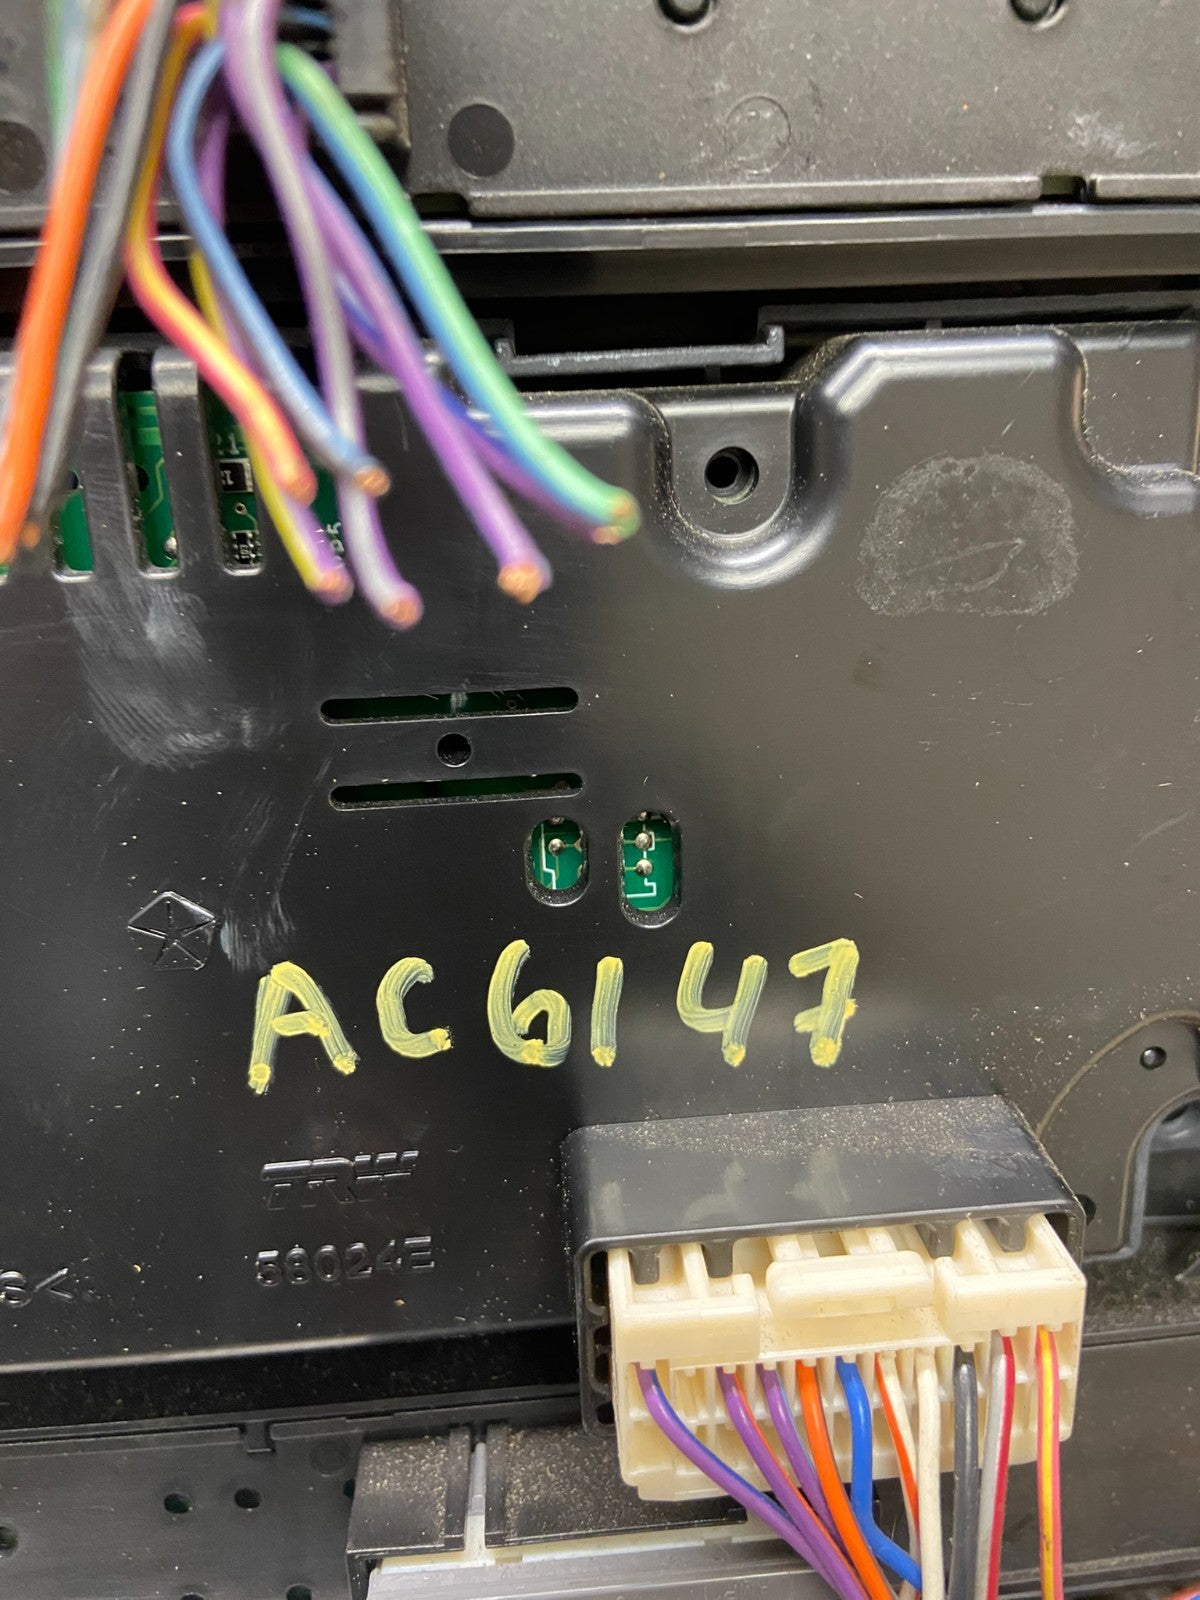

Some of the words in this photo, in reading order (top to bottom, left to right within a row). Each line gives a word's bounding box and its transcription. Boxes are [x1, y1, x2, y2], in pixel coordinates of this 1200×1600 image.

[247, 937, 861, 1095] AC6147
[261, 1150, 419, 1210] TRW
[256, 1236, 435, 1287] 58024E
